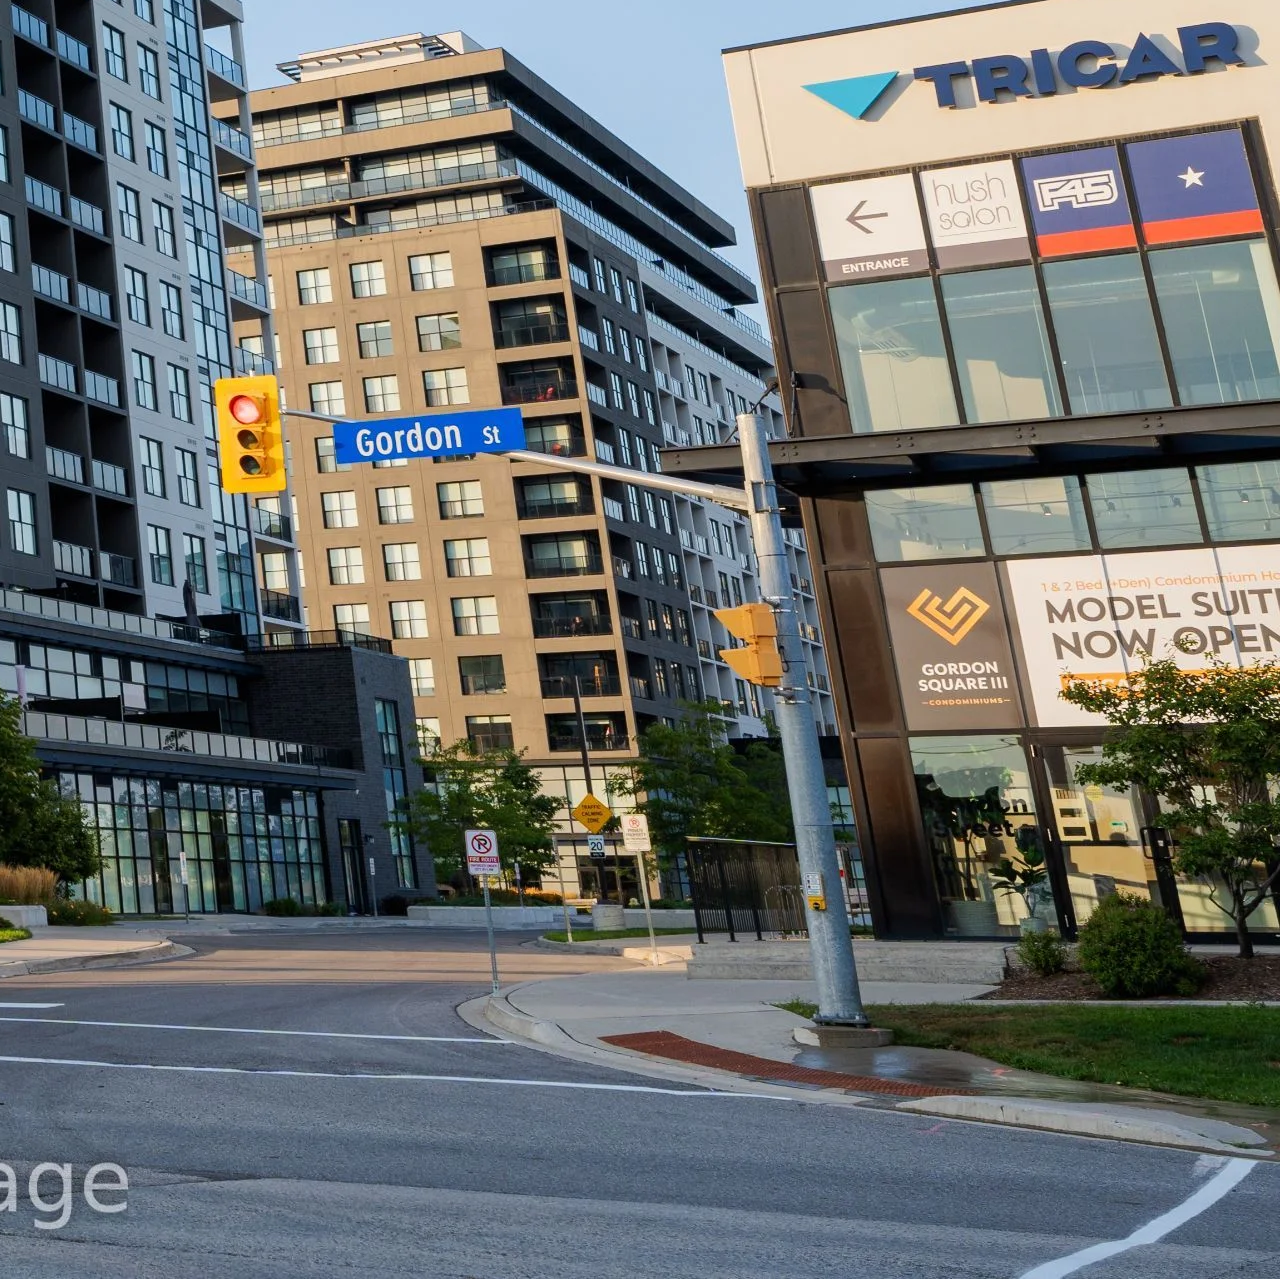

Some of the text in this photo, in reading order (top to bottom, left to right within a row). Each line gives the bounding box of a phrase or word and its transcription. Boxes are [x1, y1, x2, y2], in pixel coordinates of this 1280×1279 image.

[914, 22, 1244, 108] TRICAR
[932, 172, 1007, 207] hush
[1037, 171, 1116, 210] F45
[939, 204, 1011, 230] salon
[842, 257, 910, 274] ENTRANCE
[356, 422, 501, 457] Gordon St
[1051, 582, 1060, 592] &
[1064, 582, 1072, 591] 2
[1076, 579, 1103, 590] Bed
[1155, 571, 1257, 587] Condominium
[1045, 593, 1181, 624] MODEL
[1052, 623, 1280, 660] NOW OPEN
[922, 661, 998, 676] GORDON
[918, 676, 1008, 692] SQUARE III
[929, 698, 1003, 706] CONDOMINIUMS
[933, 819, 1016, 838] Seet
[590, 841, 603, 851] 20
